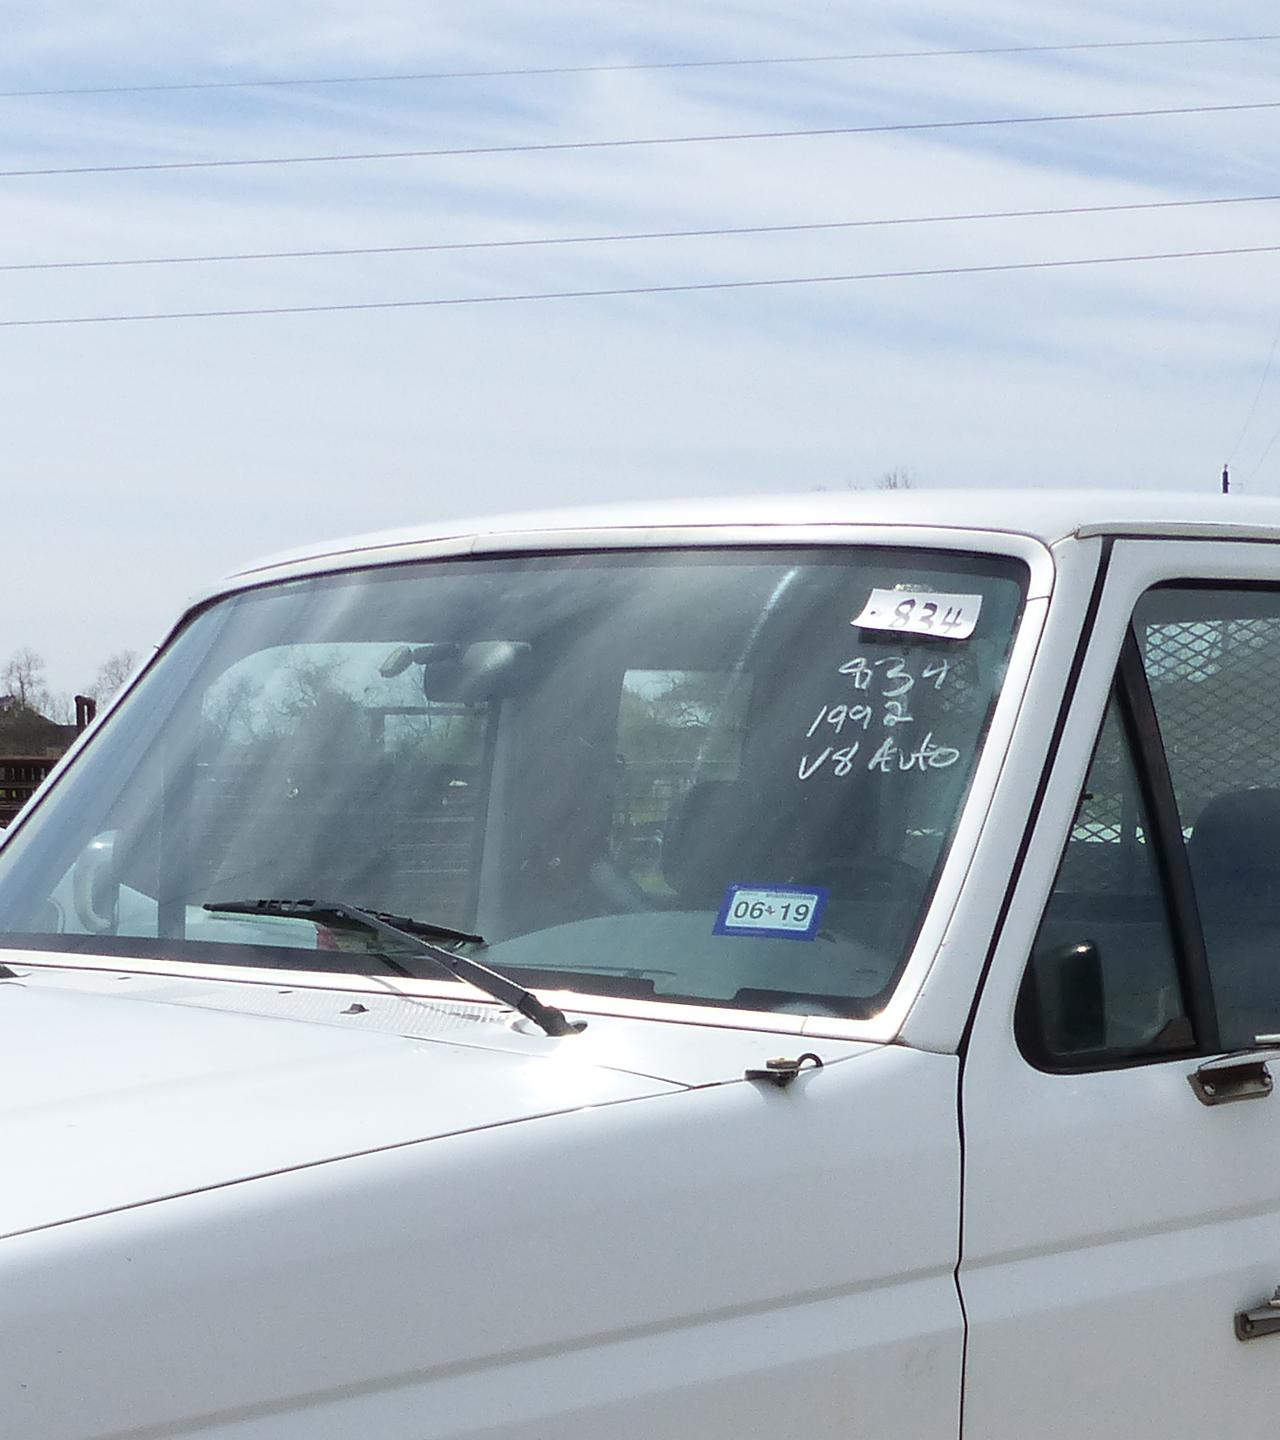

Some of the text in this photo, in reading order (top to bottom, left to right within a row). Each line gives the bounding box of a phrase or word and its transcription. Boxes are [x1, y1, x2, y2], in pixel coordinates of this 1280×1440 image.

[887, 597, 963, 634] 834
[838, 657, 951, 698] 834
[806, 700, 914, 738] 1992
[799, 732, 960, 781] V8 Auto
